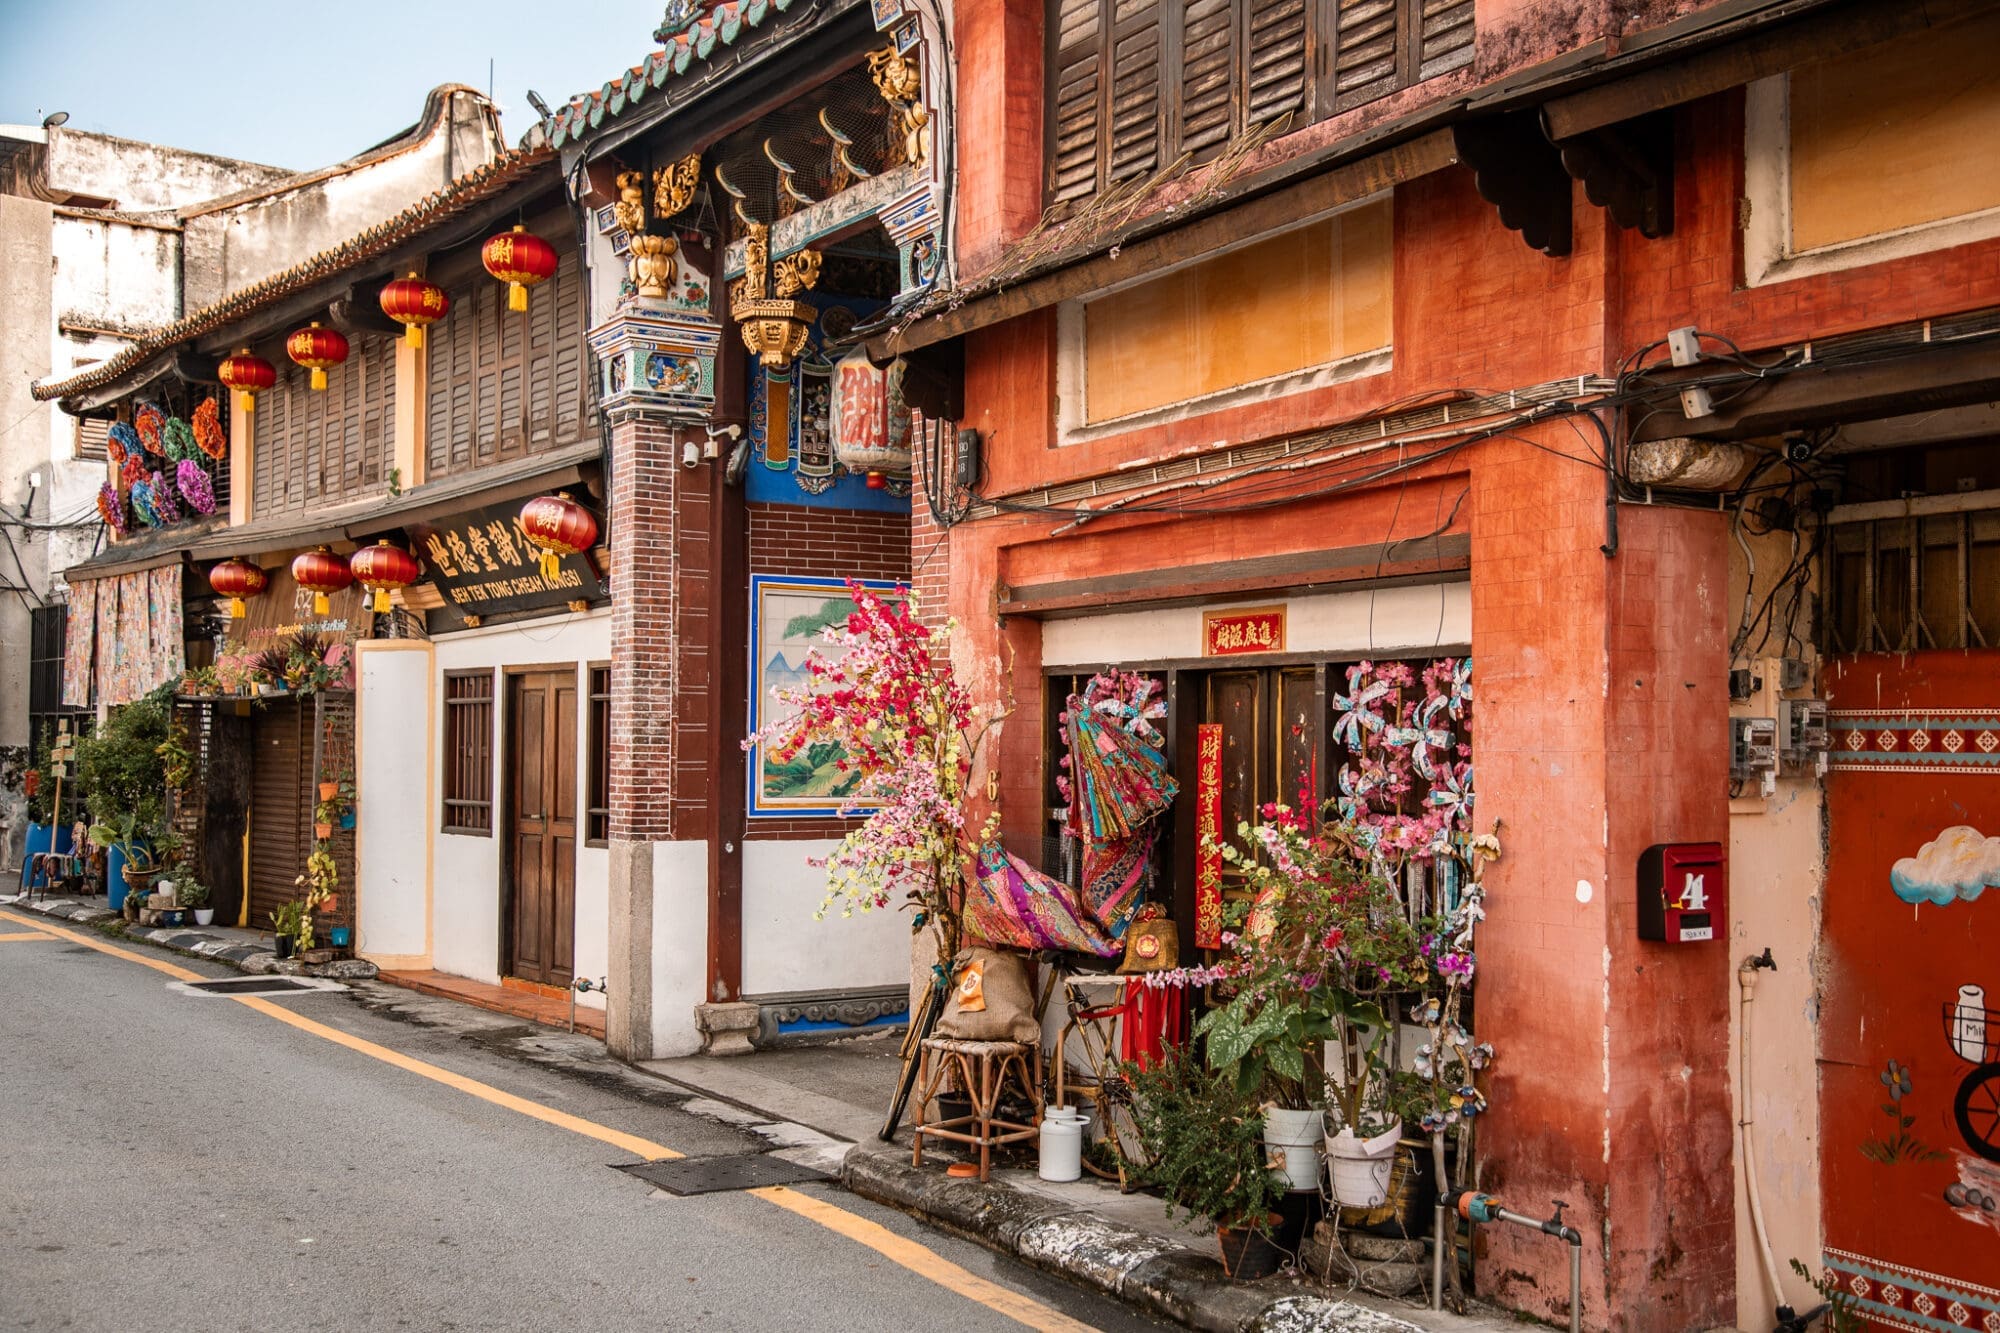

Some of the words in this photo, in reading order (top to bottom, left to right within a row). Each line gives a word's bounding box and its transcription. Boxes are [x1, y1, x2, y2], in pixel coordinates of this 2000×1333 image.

[450, 586, 472, 604] SEH
[468, 583, 490, 602] TEK
[484, 579, 514, 599] TONG
[510, 574, 546, 596] CHEAH
[541, 568, 583, 591] KONGSI
[1681, 872, 1710, 910] 4
